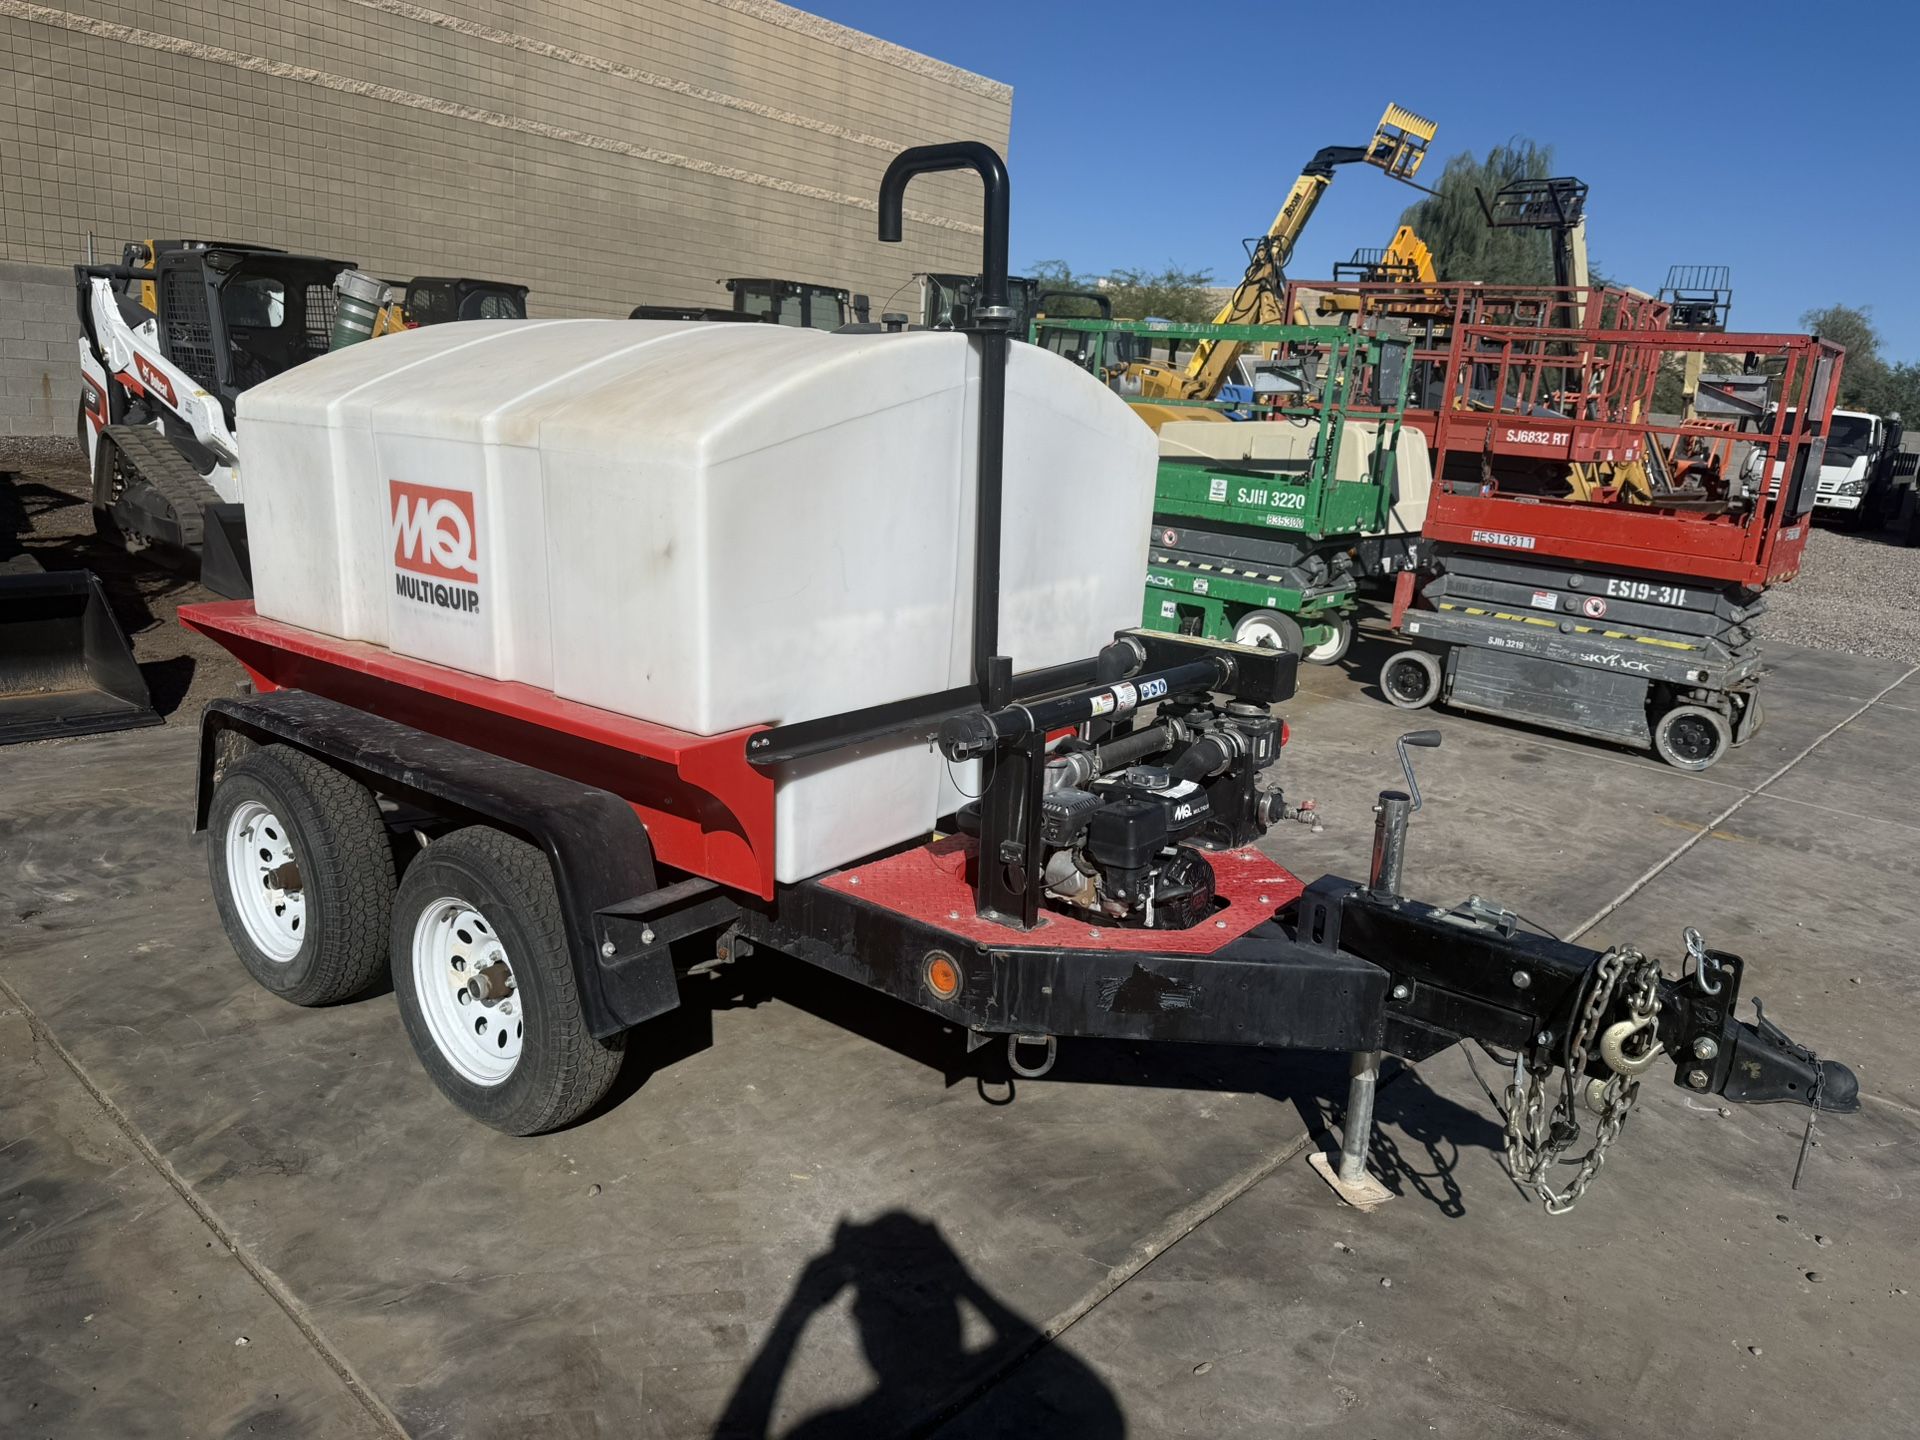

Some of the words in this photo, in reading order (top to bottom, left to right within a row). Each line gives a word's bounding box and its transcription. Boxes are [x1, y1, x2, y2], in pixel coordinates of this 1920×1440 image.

[1506, 429, 1549, 444] SJ6832
[1552, 432, 1569, 446] RT
[1271, 491, 1305, 509] 3220
[393, 494, 478, 574] MQ
[1472, 530, 1533, 548] HES19311
[396, 573, 480, 613] MULTIQUIP
[1506, 640, 1524, 650] 3219
[1174, 803, 1192, 820] MQ
